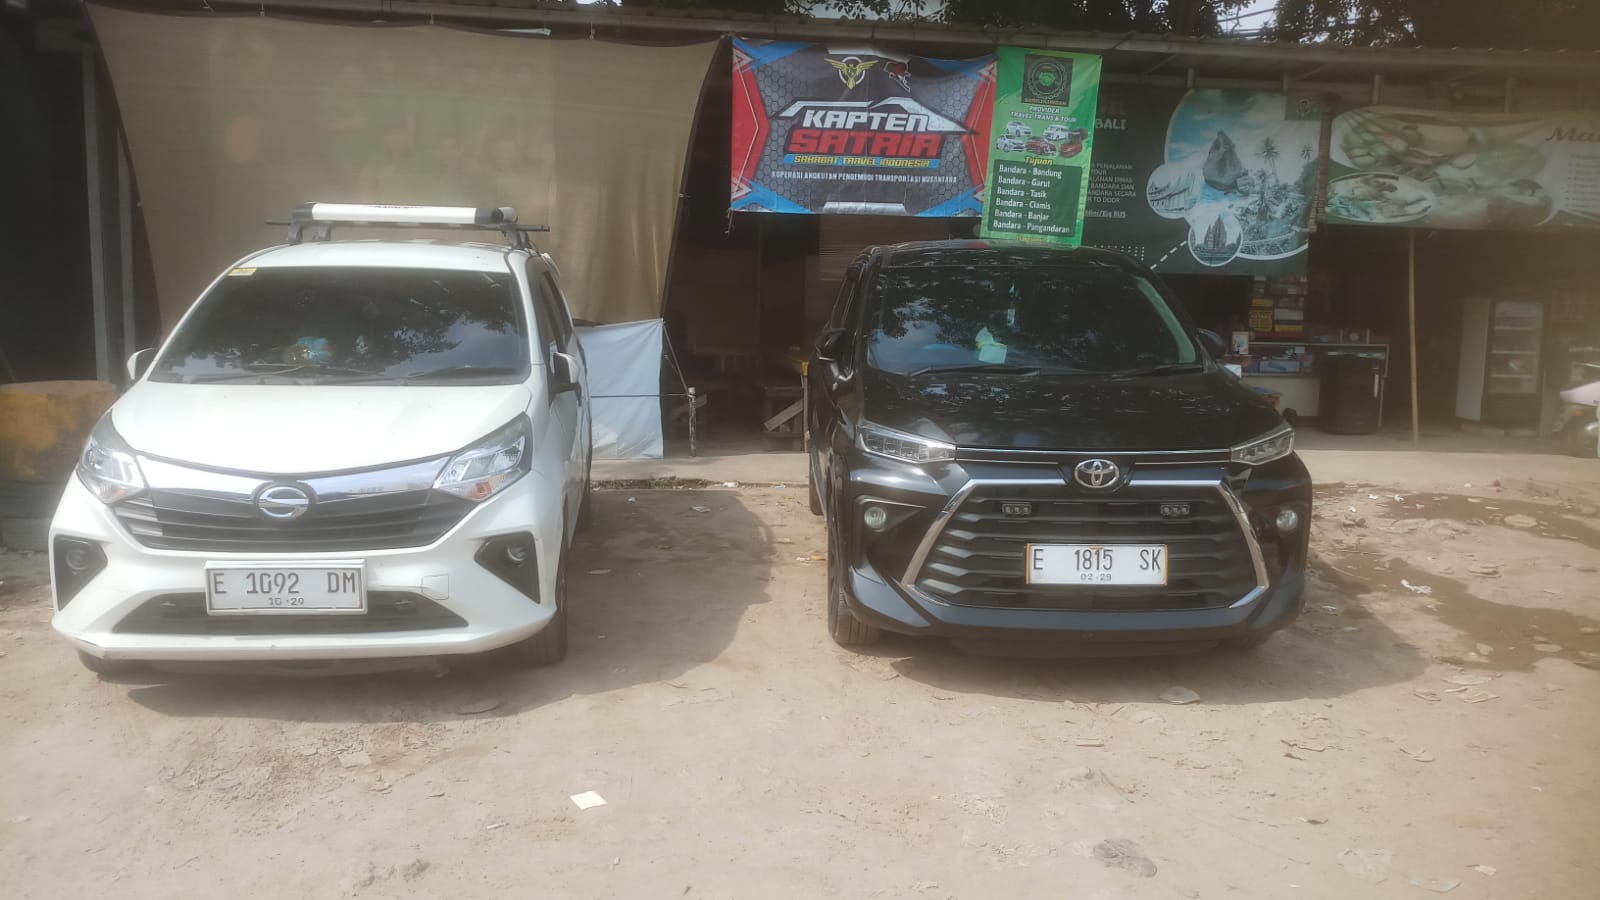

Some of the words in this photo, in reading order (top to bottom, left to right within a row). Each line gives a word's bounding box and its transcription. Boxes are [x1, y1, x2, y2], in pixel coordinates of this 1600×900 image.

[803, 110, 929, 131] KAPTEN
[1095, 118, 1127, 130] BALI
[1545, 127, 1600, 143] Ma
[789, 129, 942, 156] SATRIA
[793, 155, 837, 164] SAHABAT
[841, 157, 875, 166] TRAVEL
[879, 158, 930, 168] INDONESIA
[771, 171, 802, 179] KOPERASI
[804, 172, 836, 180] ANGKUTAN
[838, 173, 873, 182] PENGEMUDI
[875, 174, 920, 183] TRANSPORTASI
[999, 164, 1027, 174] Bandara
[1032, 168, 1062, 179] Bandung
[998, 176, 1026, 185] Bandara
[1031, 178, 1051, 188] Garut
[997, 187, 1025, 196] Bandara
[1030, 190, 1047, 199] Tasik
[995, 198, 1024, 207] Bandara
[1029, 201, 1051, 210] Ciamis
[994, 209, 1023, 218] Bandara
[1027, 212, 1050, 222] Banjar
[993, 220, 1021, 229] Bandara
[1026, 223, 1070, 233] Pangandaran
[1033, 549, 1044, 570] E
[1074, 549, 1114, 571] 1815
[1139, 549, 1161, 571] SK
[213, 573, 227, 594] E
[246, 573, 299, 594] 1092
[327, 572, 356, 593] DM
